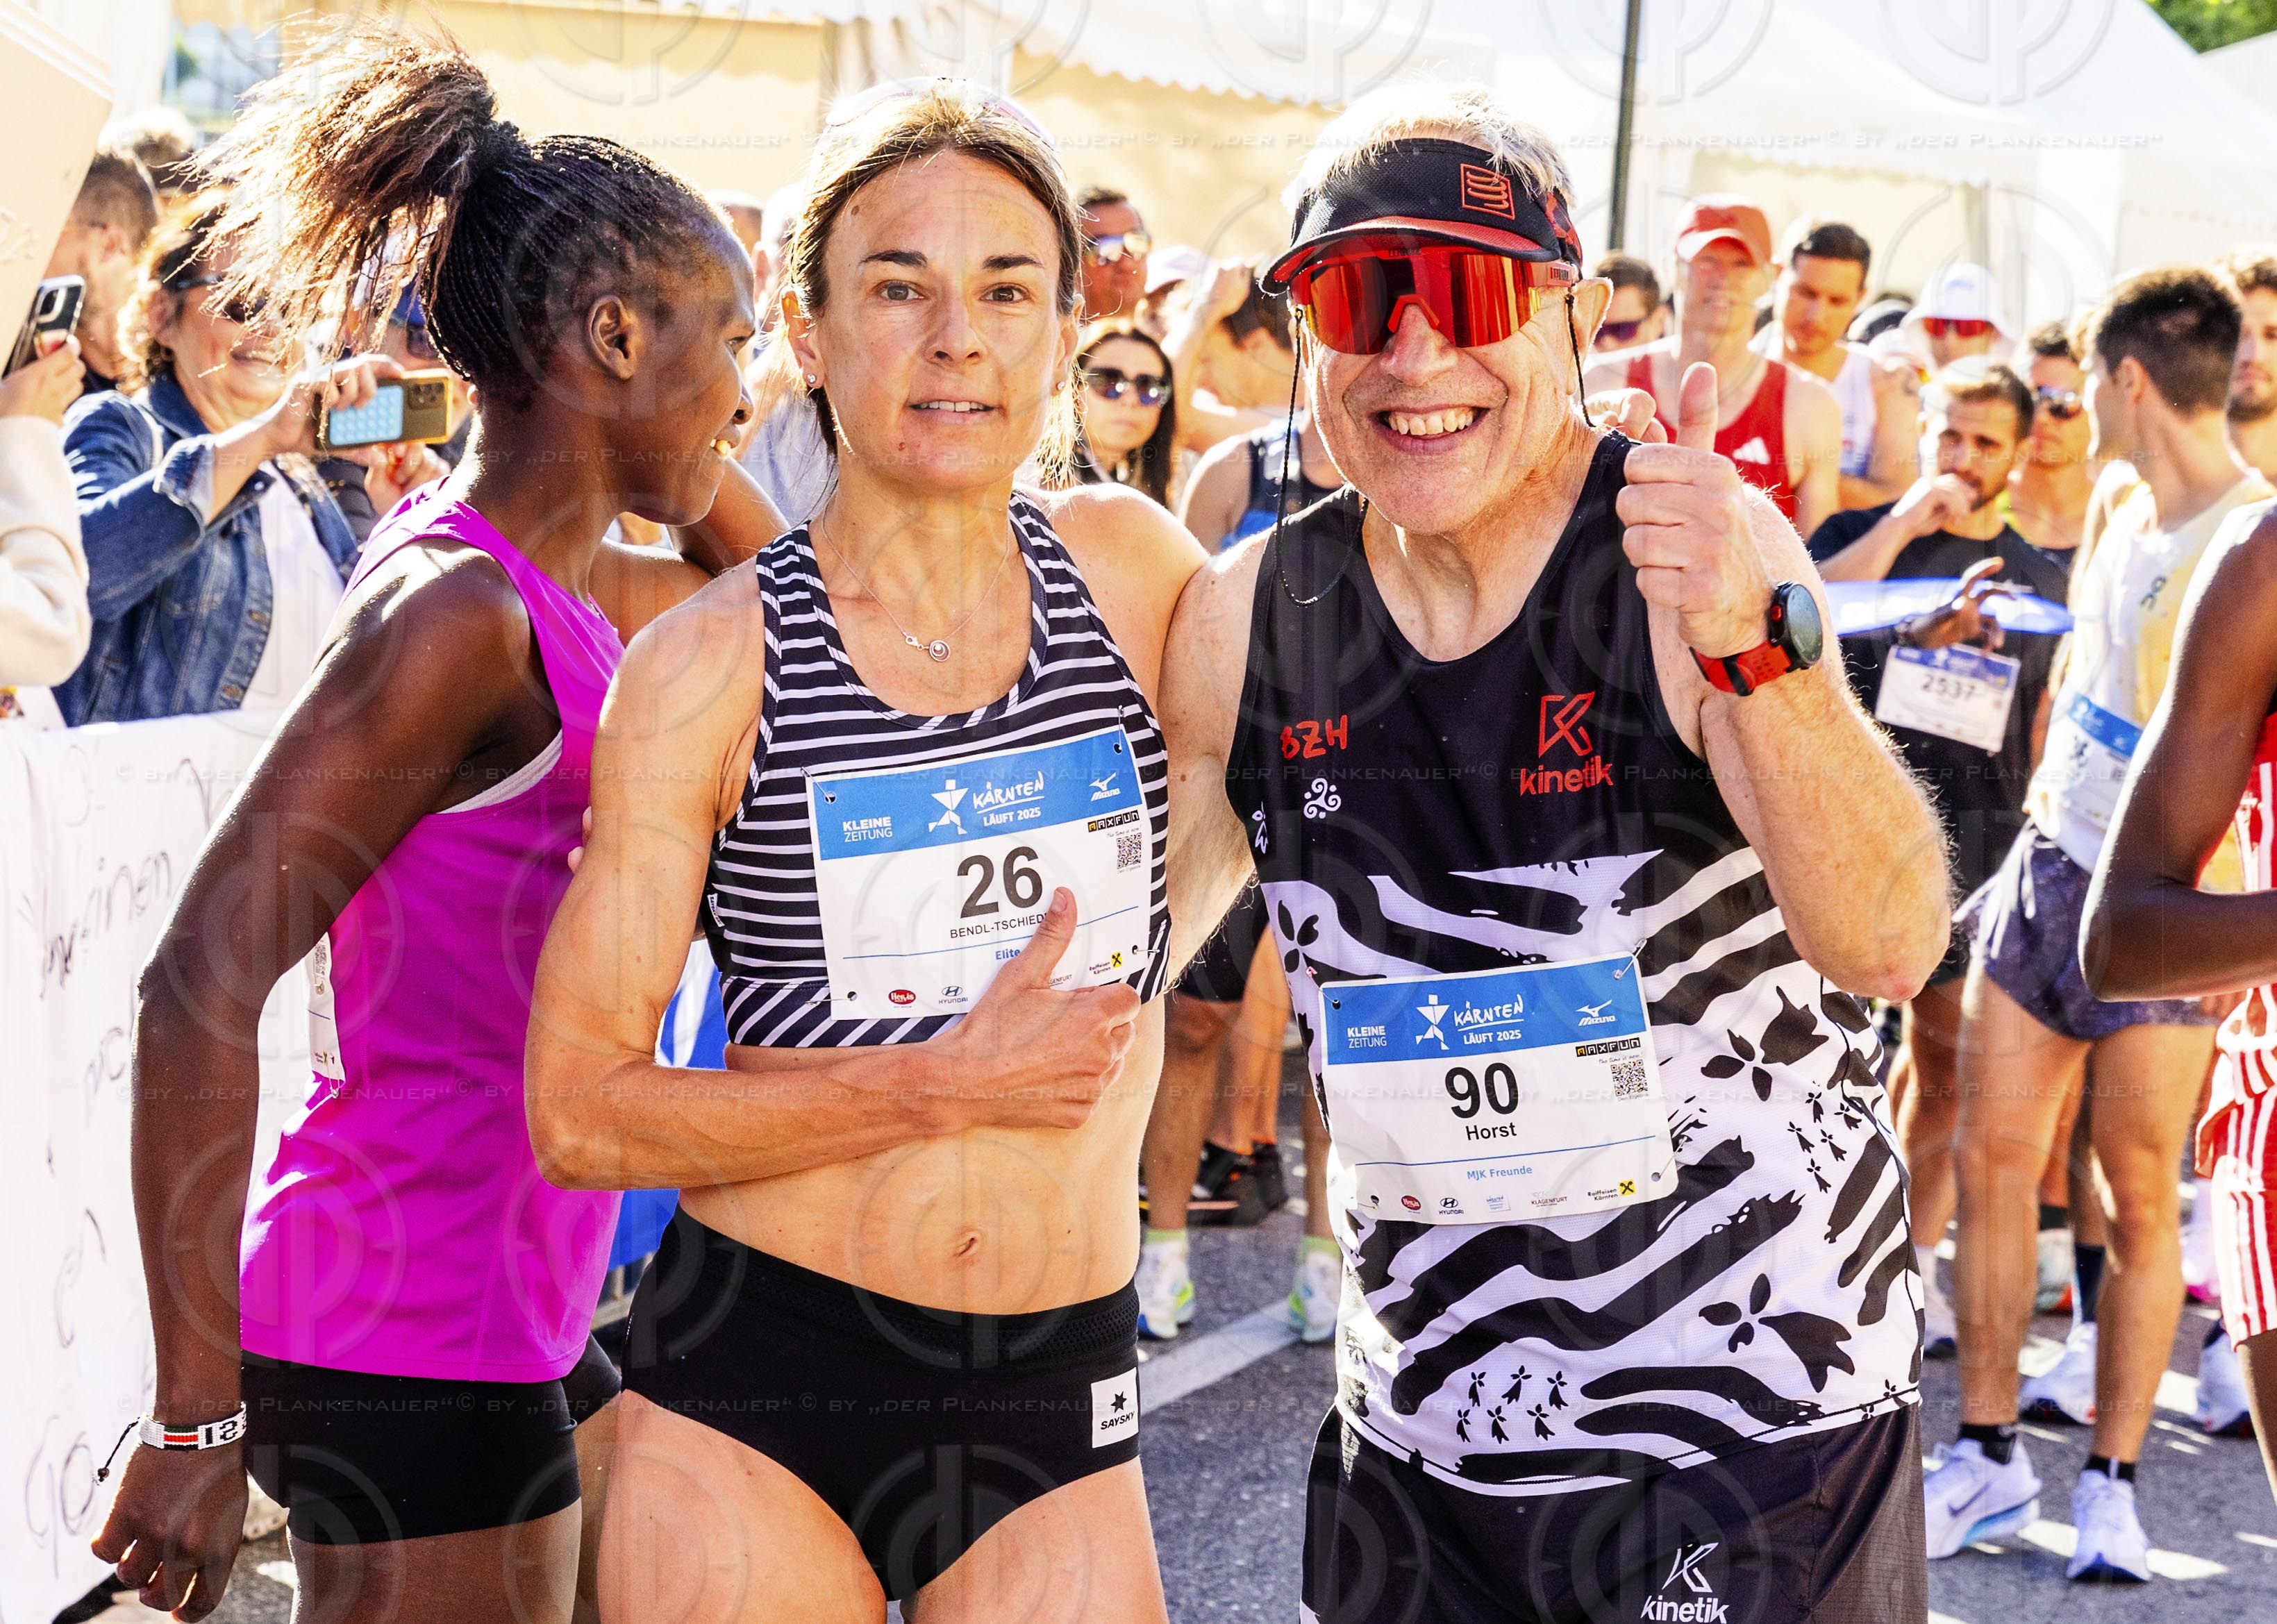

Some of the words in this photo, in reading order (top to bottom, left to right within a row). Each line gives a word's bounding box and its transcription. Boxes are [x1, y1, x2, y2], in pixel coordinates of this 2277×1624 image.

[1520, 755, 1614, 796] kinetik
[843, 817, 892, 832] KLEINE
[983, 811, 1014, 826] LÄUFT
[1017, 807, 1041, 821] 2025
[844, 827, 893, 842] ZEITUNG
[956, 846, 1043, 919] 26
[950, 912, 1046, 939] BENDL-TSCHIED
[995, 948, 1020, 960] Elite
[1347, 1026, 1385, 1037] KLEINE
[1463, 1032, 1493, 1044] LÄUFT
[1496, 1030, 1521, 1041] 2025
[1348, 1036, 1387, 1048] ZEITUNG
[1445, 1062, 1519, 1119] 90
[1466, 1122, 1517, 1140] Horst
[1490, 1166, 1533, 1178] Freunde
[1531, 1196, 1567, 1205] KLAGENFURT
[1101, 1411, 1135, 1430] SAYSKY
[1640, 1595, 1730, 1624] kinetik
